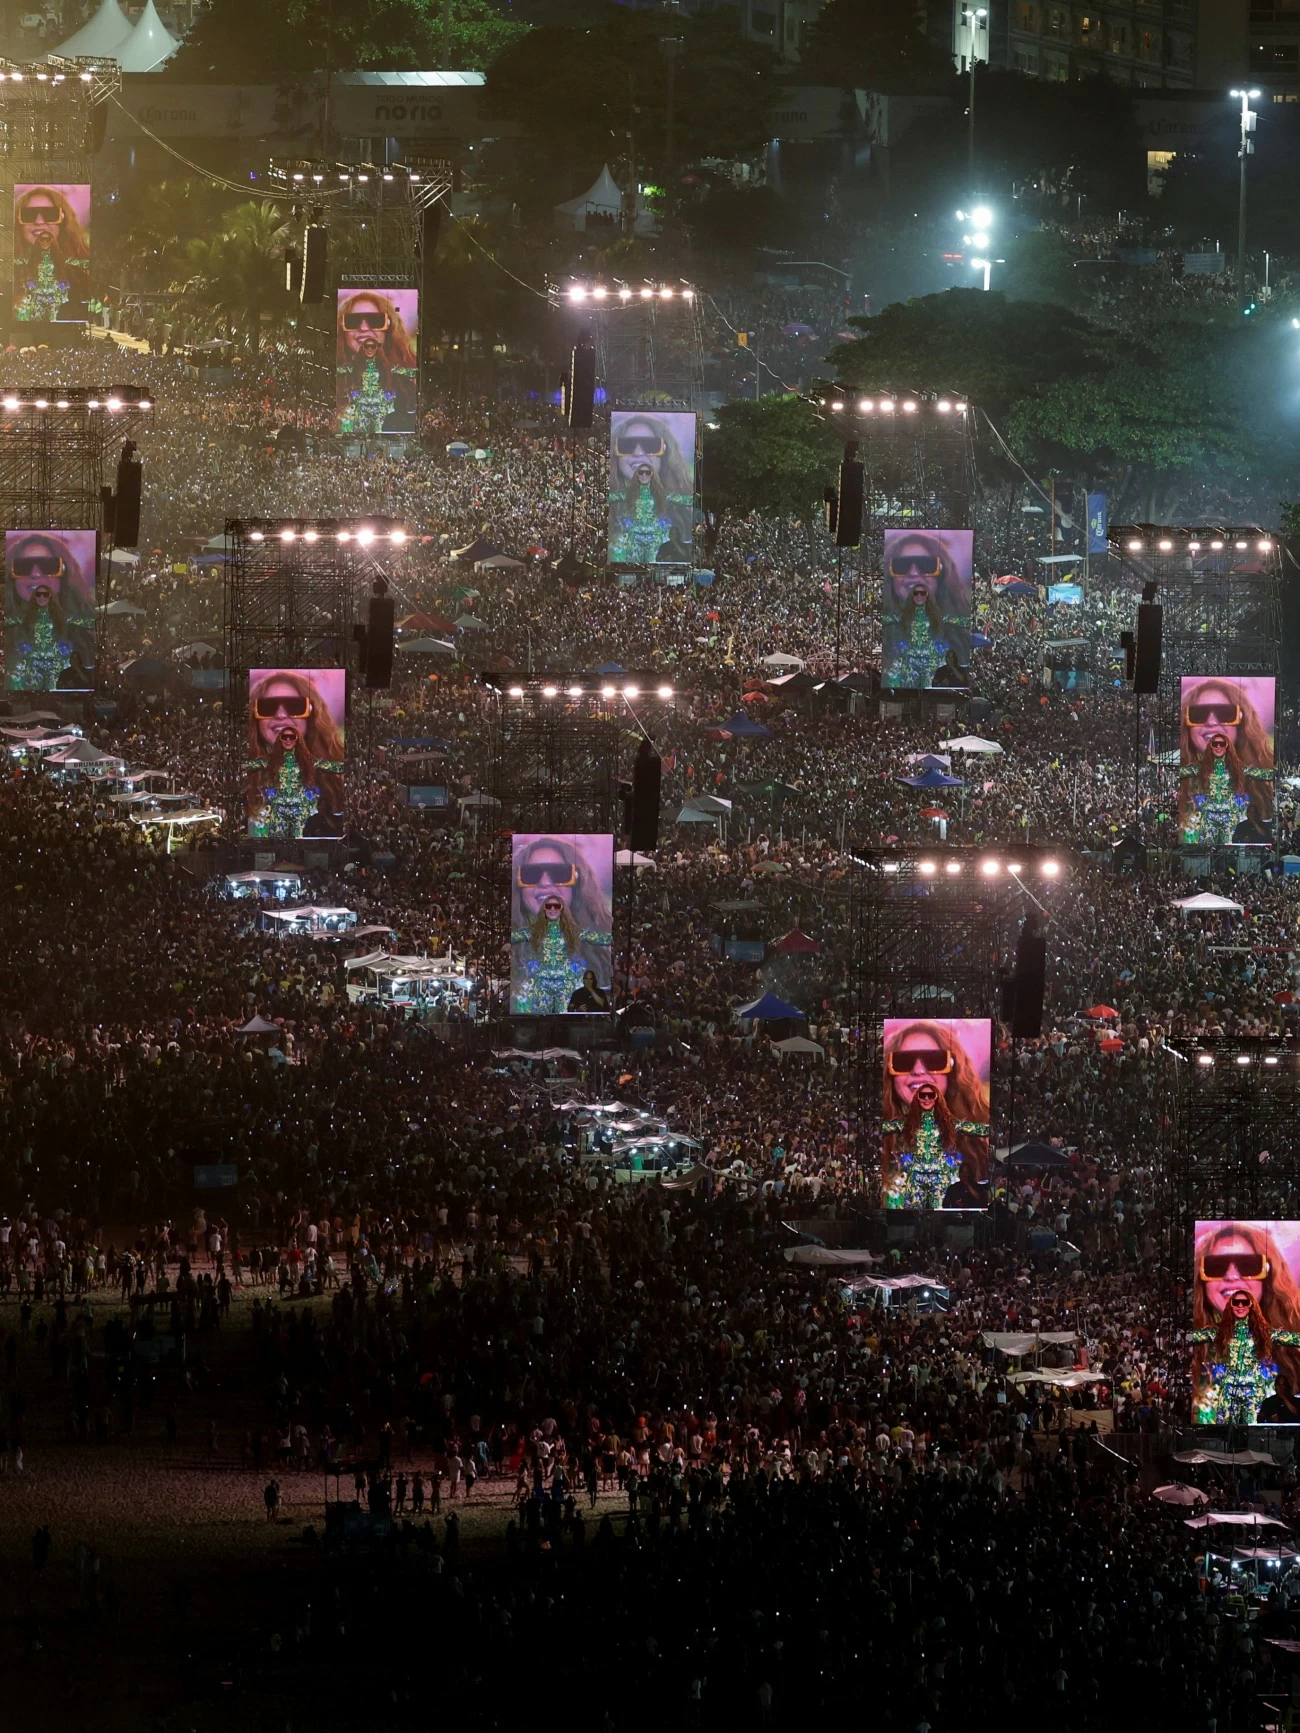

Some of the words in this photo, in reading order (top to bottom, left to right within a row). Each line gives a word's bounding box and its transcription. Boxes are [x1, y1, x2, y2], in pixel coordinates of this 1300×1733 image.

[138, 106, 197, 124] Corona
[1095, 510, 1104, 537] Corona
[73, 760, 104, 768] BRUMAR
